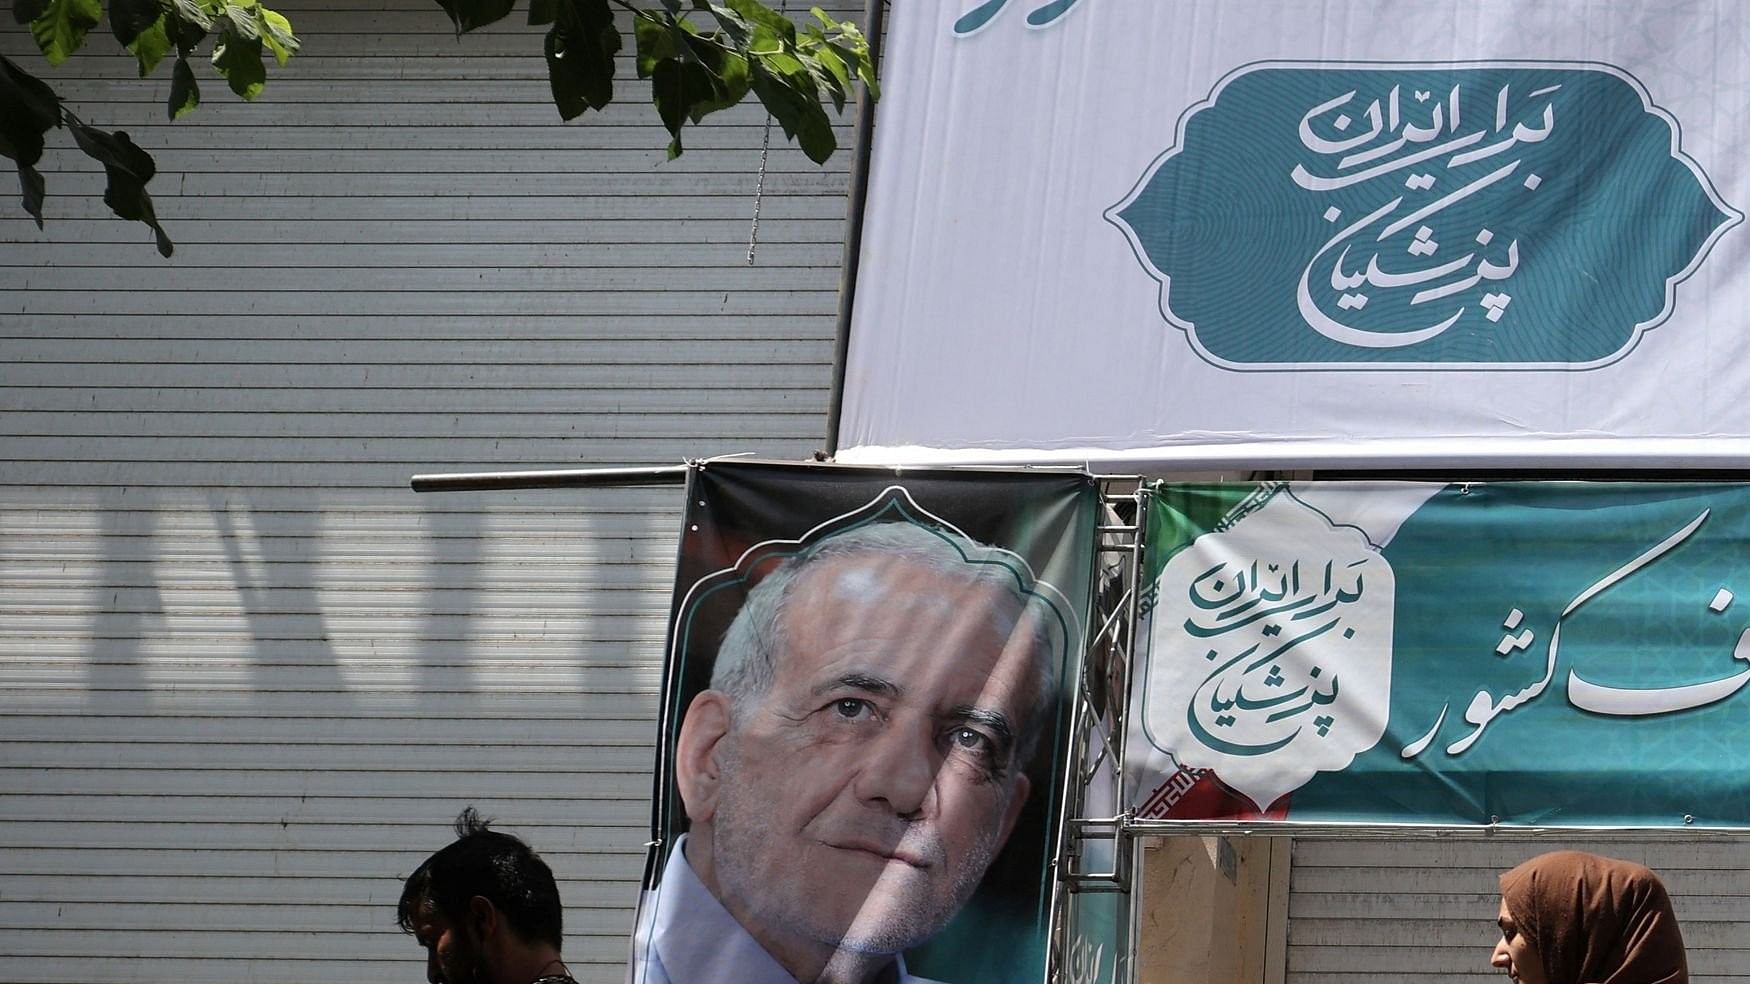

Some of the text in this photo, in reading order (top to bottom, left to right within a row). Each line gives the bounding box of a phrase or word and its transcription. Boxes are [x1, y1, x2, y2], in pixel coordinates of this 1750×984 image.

[1299, 84, 1460, 169] ایران
[1297, 160, 1520, 347] پزشکیان
[1189, 560, 1300, 622] ایران
[1402, 507, 1710, 758] کشور
[1187, 617, 1341, 756] پزشکیان
